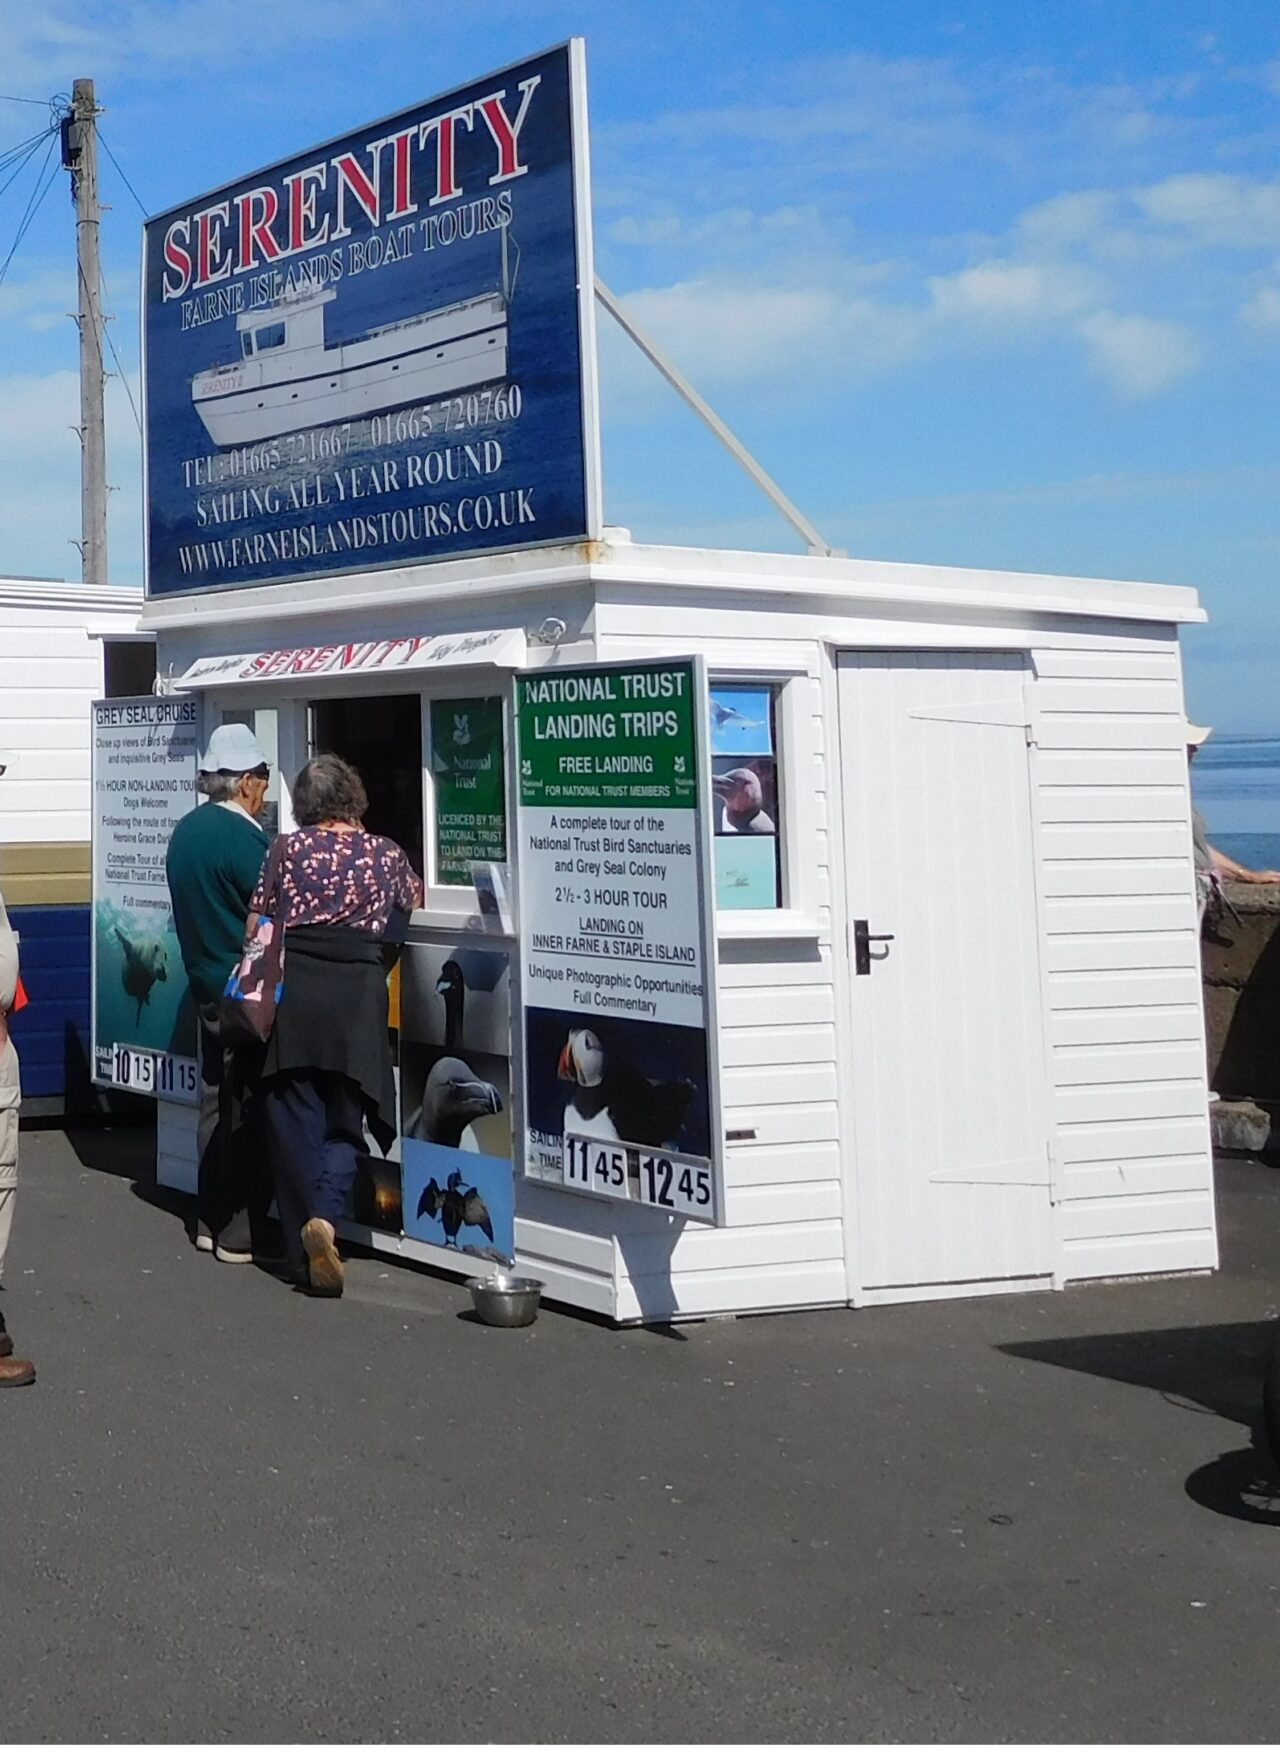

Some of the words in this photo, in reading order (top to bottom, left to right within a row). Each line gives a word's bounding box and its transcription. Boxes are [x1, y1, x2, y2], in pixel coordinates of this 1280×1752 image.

[162, 75, 541, 302] SERENITY
[181, 282, 245, 331] FARNE
[249, 248, 343, 309] ISLANDS
[348, 222, 415, 276] BOAT
[419, 190, 513, 251] TOURS
[182, 460, 225, 489] TEL:
[229, 441, 281, 476] 01665
[286, 423, 352, 462] 721667
[371, 401, 433, 443] 01665
[441, 384, 522, 430] 720760
[196, 484, 281, 528] SAILING
[286, 474, 332, 510] ALL
[335, 459, 400, 500] YEAR
[407, 439, 502, 486] ROUND
[179, 488, 535, 575] WWW.FARNEISLANDSTOURS.CO.UK
[239, 636, 435, 680] SERENITY
[525, 676, 616, 704] NATIONAL
[621, 672, 686, 699] TRUST
[96, 707, 124, 725] GREY
[126, 706, 154, 724] SEAL
[156, 702, 197, 722] CRUISE
[534, 713, 617, 739] LANDING
[621, 710, 678, 738] TRIPS
[108, 754, 120, 765] and
[151, 752, 167, 766] Grey
[559, 756, 592, 774] FREE
[595, 756, 653, 774] LANDING
[106, 780, 127, 792] HOUR
[128, 780, 178, 792] NON-LANDING
[454, 773, 478, 789] Trust
[545, 785, 561, 796] FOR
[562, 785, 601, 797] NATIONAL
[602, 785, 627, 797] TRUST
[630, 785, 670, 797] MEMBERS
[123, 797, 139, 810] Dogs
[141, 797, 169, 809] Welcome
[132, 818, 142, 828] the
[160, 817, 167, 828] of
[438, 814, 475, 826] LICENCED
[476, 814, 487, 826] BY
[488, 815, 504, 827] THE
[550, 815, 558, 829] A
[560, 816, 607, 833] complete
[610, 817, 631, 831] tour
[634, 816, 645, 831] of
[647, 817, 664, 832] the
[138, 832, 156, 844] Grace
[439, 829, 476, 842] NATIONAL
[478, 830, 502, 843] TRUST
[530, 836, 571, 851] National
[573, 837, 601, 852] Trust
[603, 838, 625, 853] Bird
[628, 838, 691, 855] Sanctuaries
[107, 852, 136, 866] Complete
[137, 853, 151, 865] Tour
[152, 854, 159, 866] of
[441, 845, 452, 856] TO
[452, 845, 472, 857] LAND
[473, 846, 486, 857] ON
[105, 869, 130, 880] National
[131, 870, 147, 881] Trust
[555, 859, 573, 873] and
[576, 861, 600, 877] Grey
[604, 861, 626, 875] Seal
[629, 861, 667, 881] Colony
[123, 896, 135, 907] Full
[584, 889, 591, 905] 3
[594, 890, 630, 907] HOUR
[632, 891, 668, 909] TOUR
[579, 917, 625, 933] LANDING
[628, 920, 644, 935] ON
[532, 934, 563, 950] INNER
[566, 937, 600, 953] FARNE
[603, 940, 610, 954] &
[613, 941, 653, 958] STAPLE
[655, 945, 696, 962] ISLAND
[528, 964, 564, 982] Unique
[566, 967, 631, 990] Photographic
[635, 975, 704, 996] Opportunities
[573, 989, 591, 1005] Full
[594, 992, 657, 1016] Commentary
[115, 1050, 131, 1084] 10
[135, 1056, 151, 1082] 15
[161, 1056, 174, 1091] 11
[179, 1065, 196, 1091] 15
[529, 1130, 563, 1148] SAILIN
[567, 1138, 588, 1182] 11
[595, 1151, 625, 1186] 45
[643, 1156, 675, 1208] 12
[678, 1168, 710, 1205] 45
